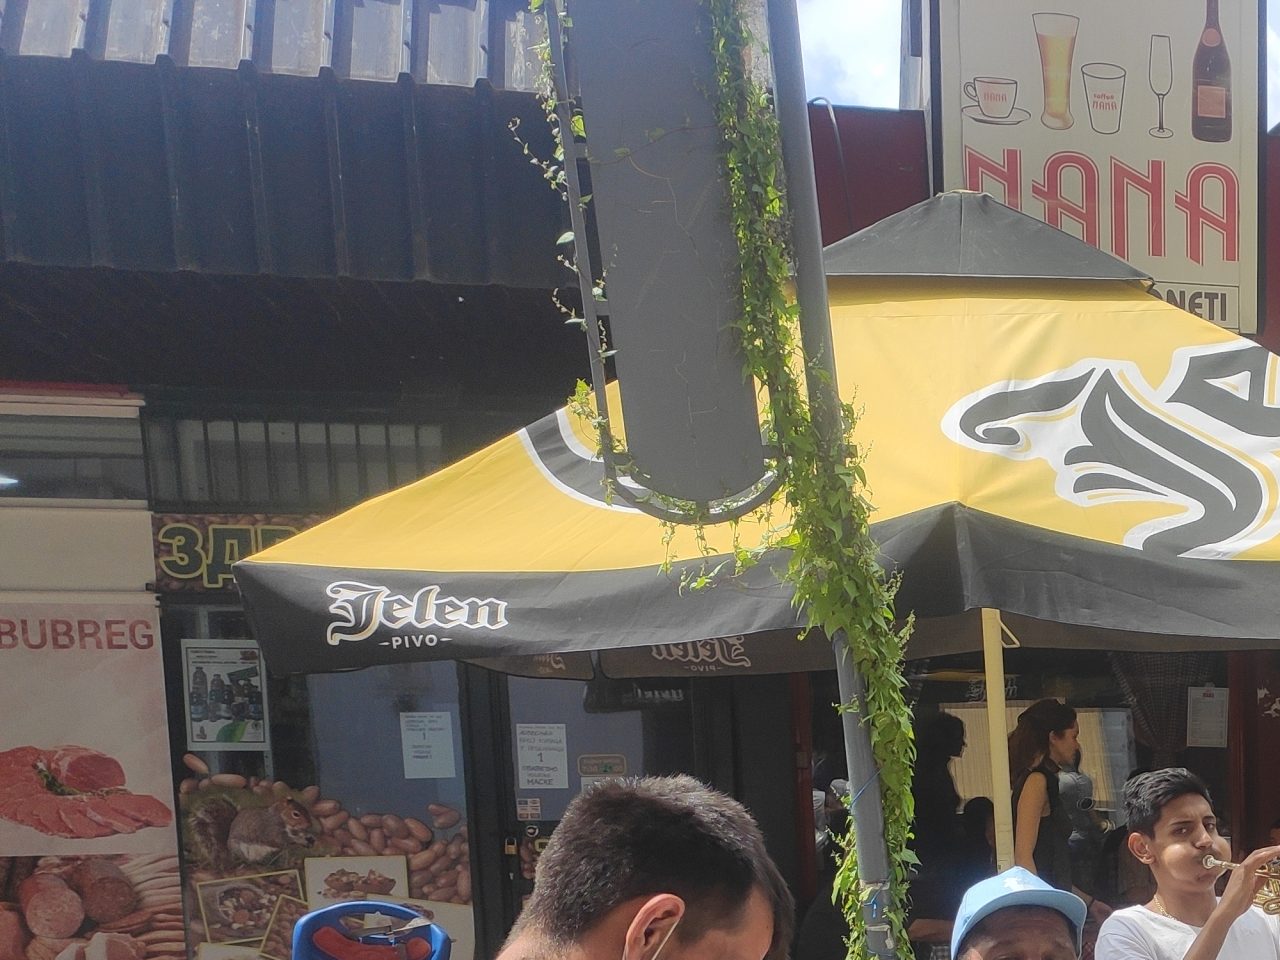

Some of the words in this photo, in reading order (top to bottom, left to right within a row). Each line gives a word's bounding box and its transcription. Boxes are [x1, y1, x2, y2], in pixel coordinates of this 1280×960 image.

[964, 144, 1240, 266] NANA
[0, 618, 154, 650] BUBREG
[326, 581, 508, 645] Jelen
[391, 634, 438, 649] PIVO
